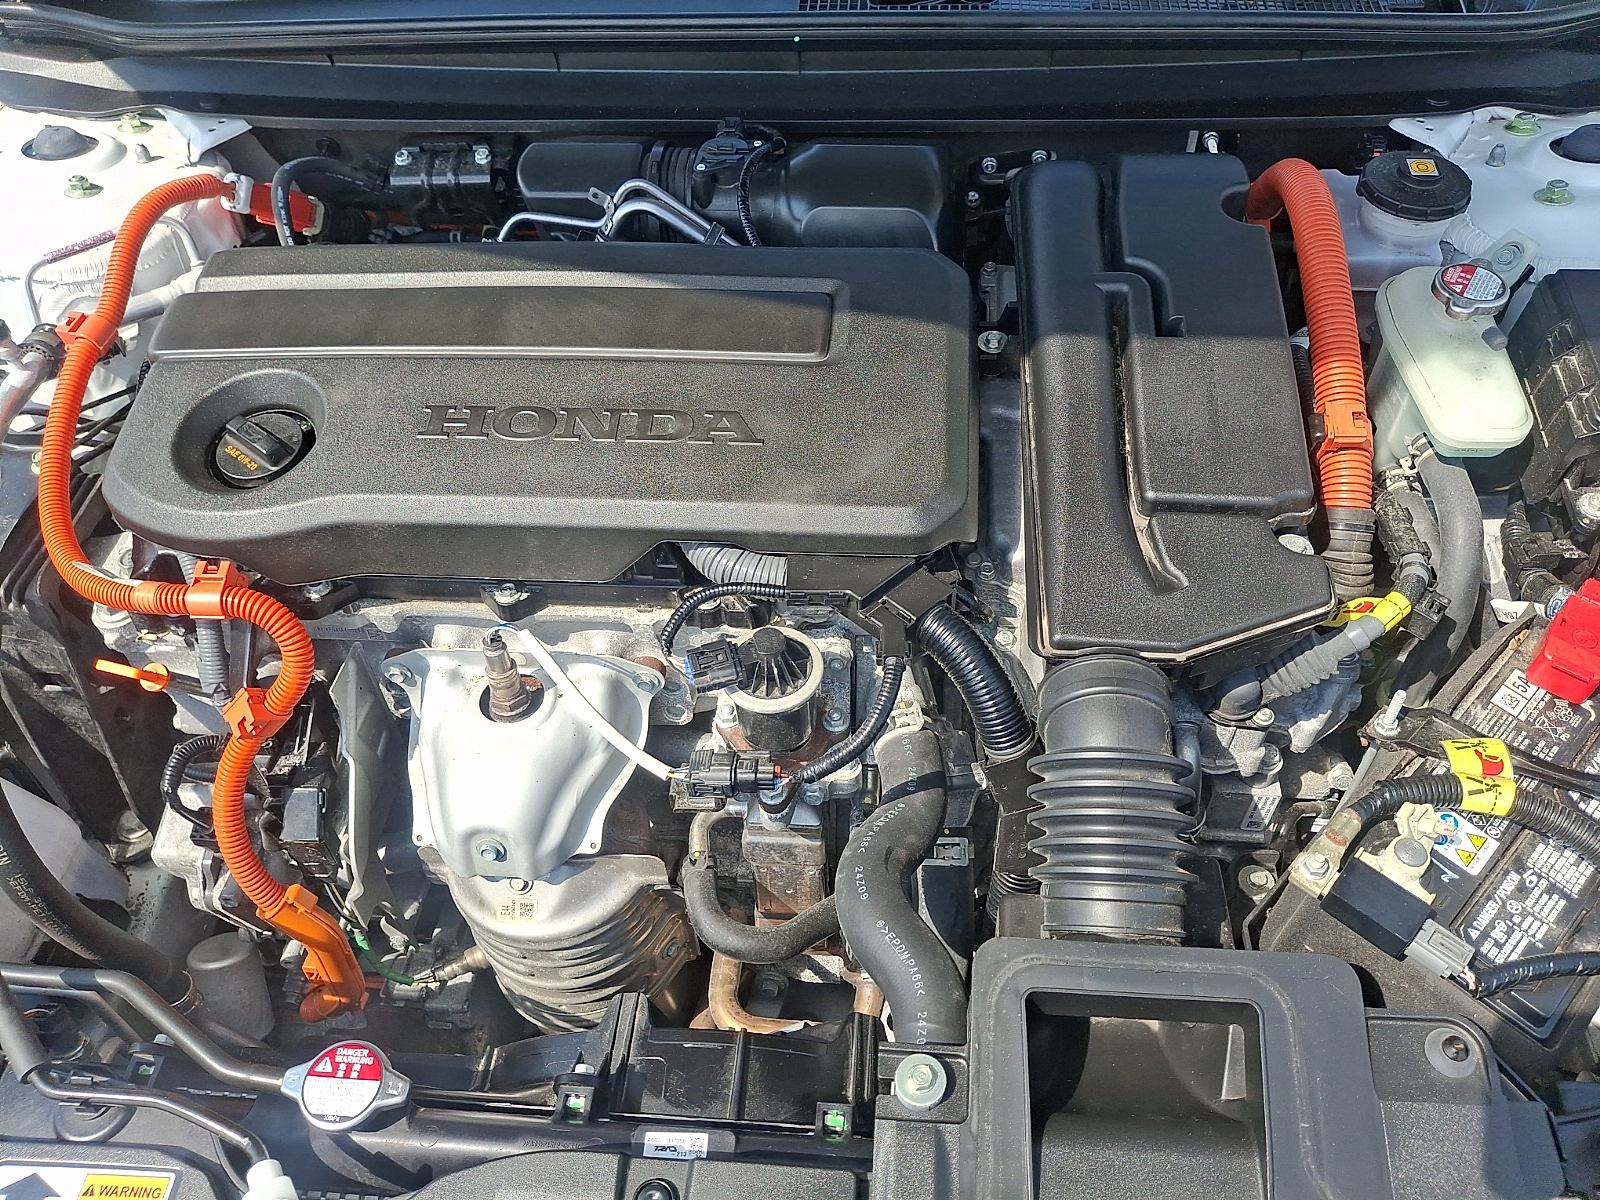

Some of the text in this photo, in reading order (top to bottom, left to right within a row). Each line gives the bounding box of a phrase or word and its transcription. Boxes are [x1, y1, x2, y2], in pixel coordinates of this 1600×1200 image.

[416, 406, 764, 446] HONDA
[224, 445, 258, 471] SAE 0W-20
[854, 866, 869, 900] 24Z09
[335, 1056, 374, 1064] WARNUNG
[336, 1048, 369, 1056] DANGER
[99, 1184, 162, 1199] WARNING
